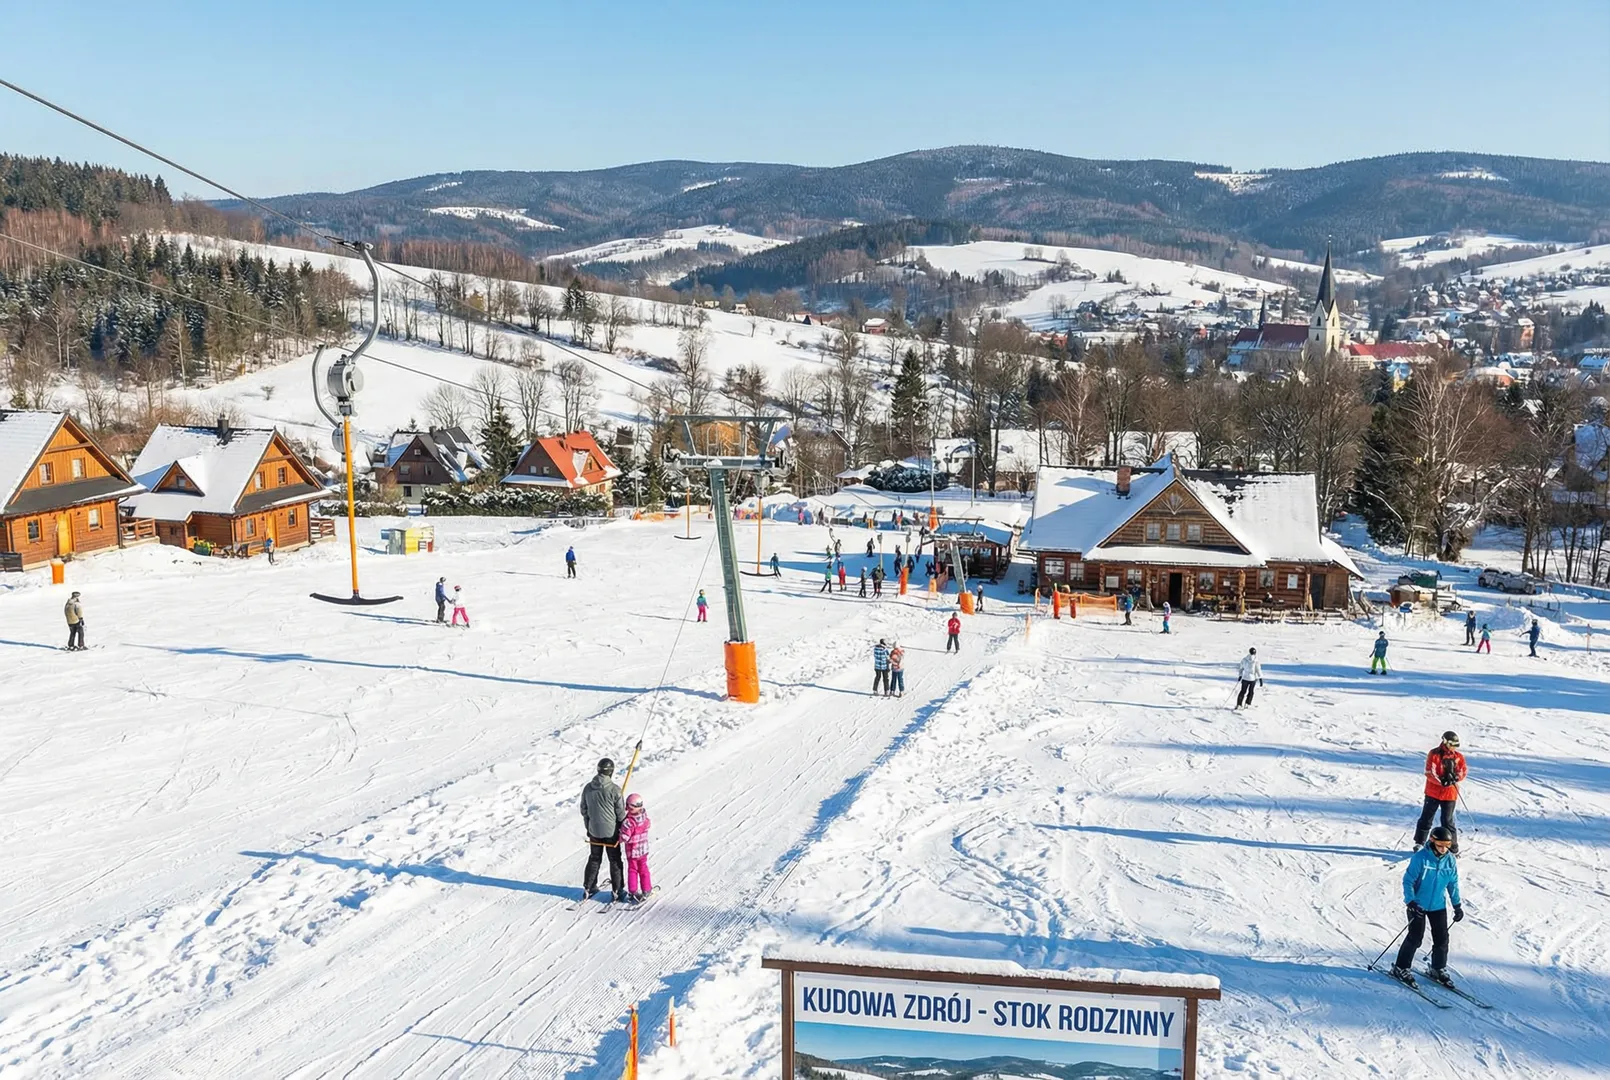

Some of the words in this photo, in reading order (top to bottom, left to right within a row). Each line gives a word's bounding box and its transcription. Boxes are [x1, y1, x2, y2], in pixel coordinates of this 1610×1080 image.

[803, 986, 897, 1018] KUDOWA
[903, 992, 971, 1024] ZDRÓJ
[993, 1000, 1052, 1029] STOK
[1058, 1004, 1175, 1038] RODZINNY
